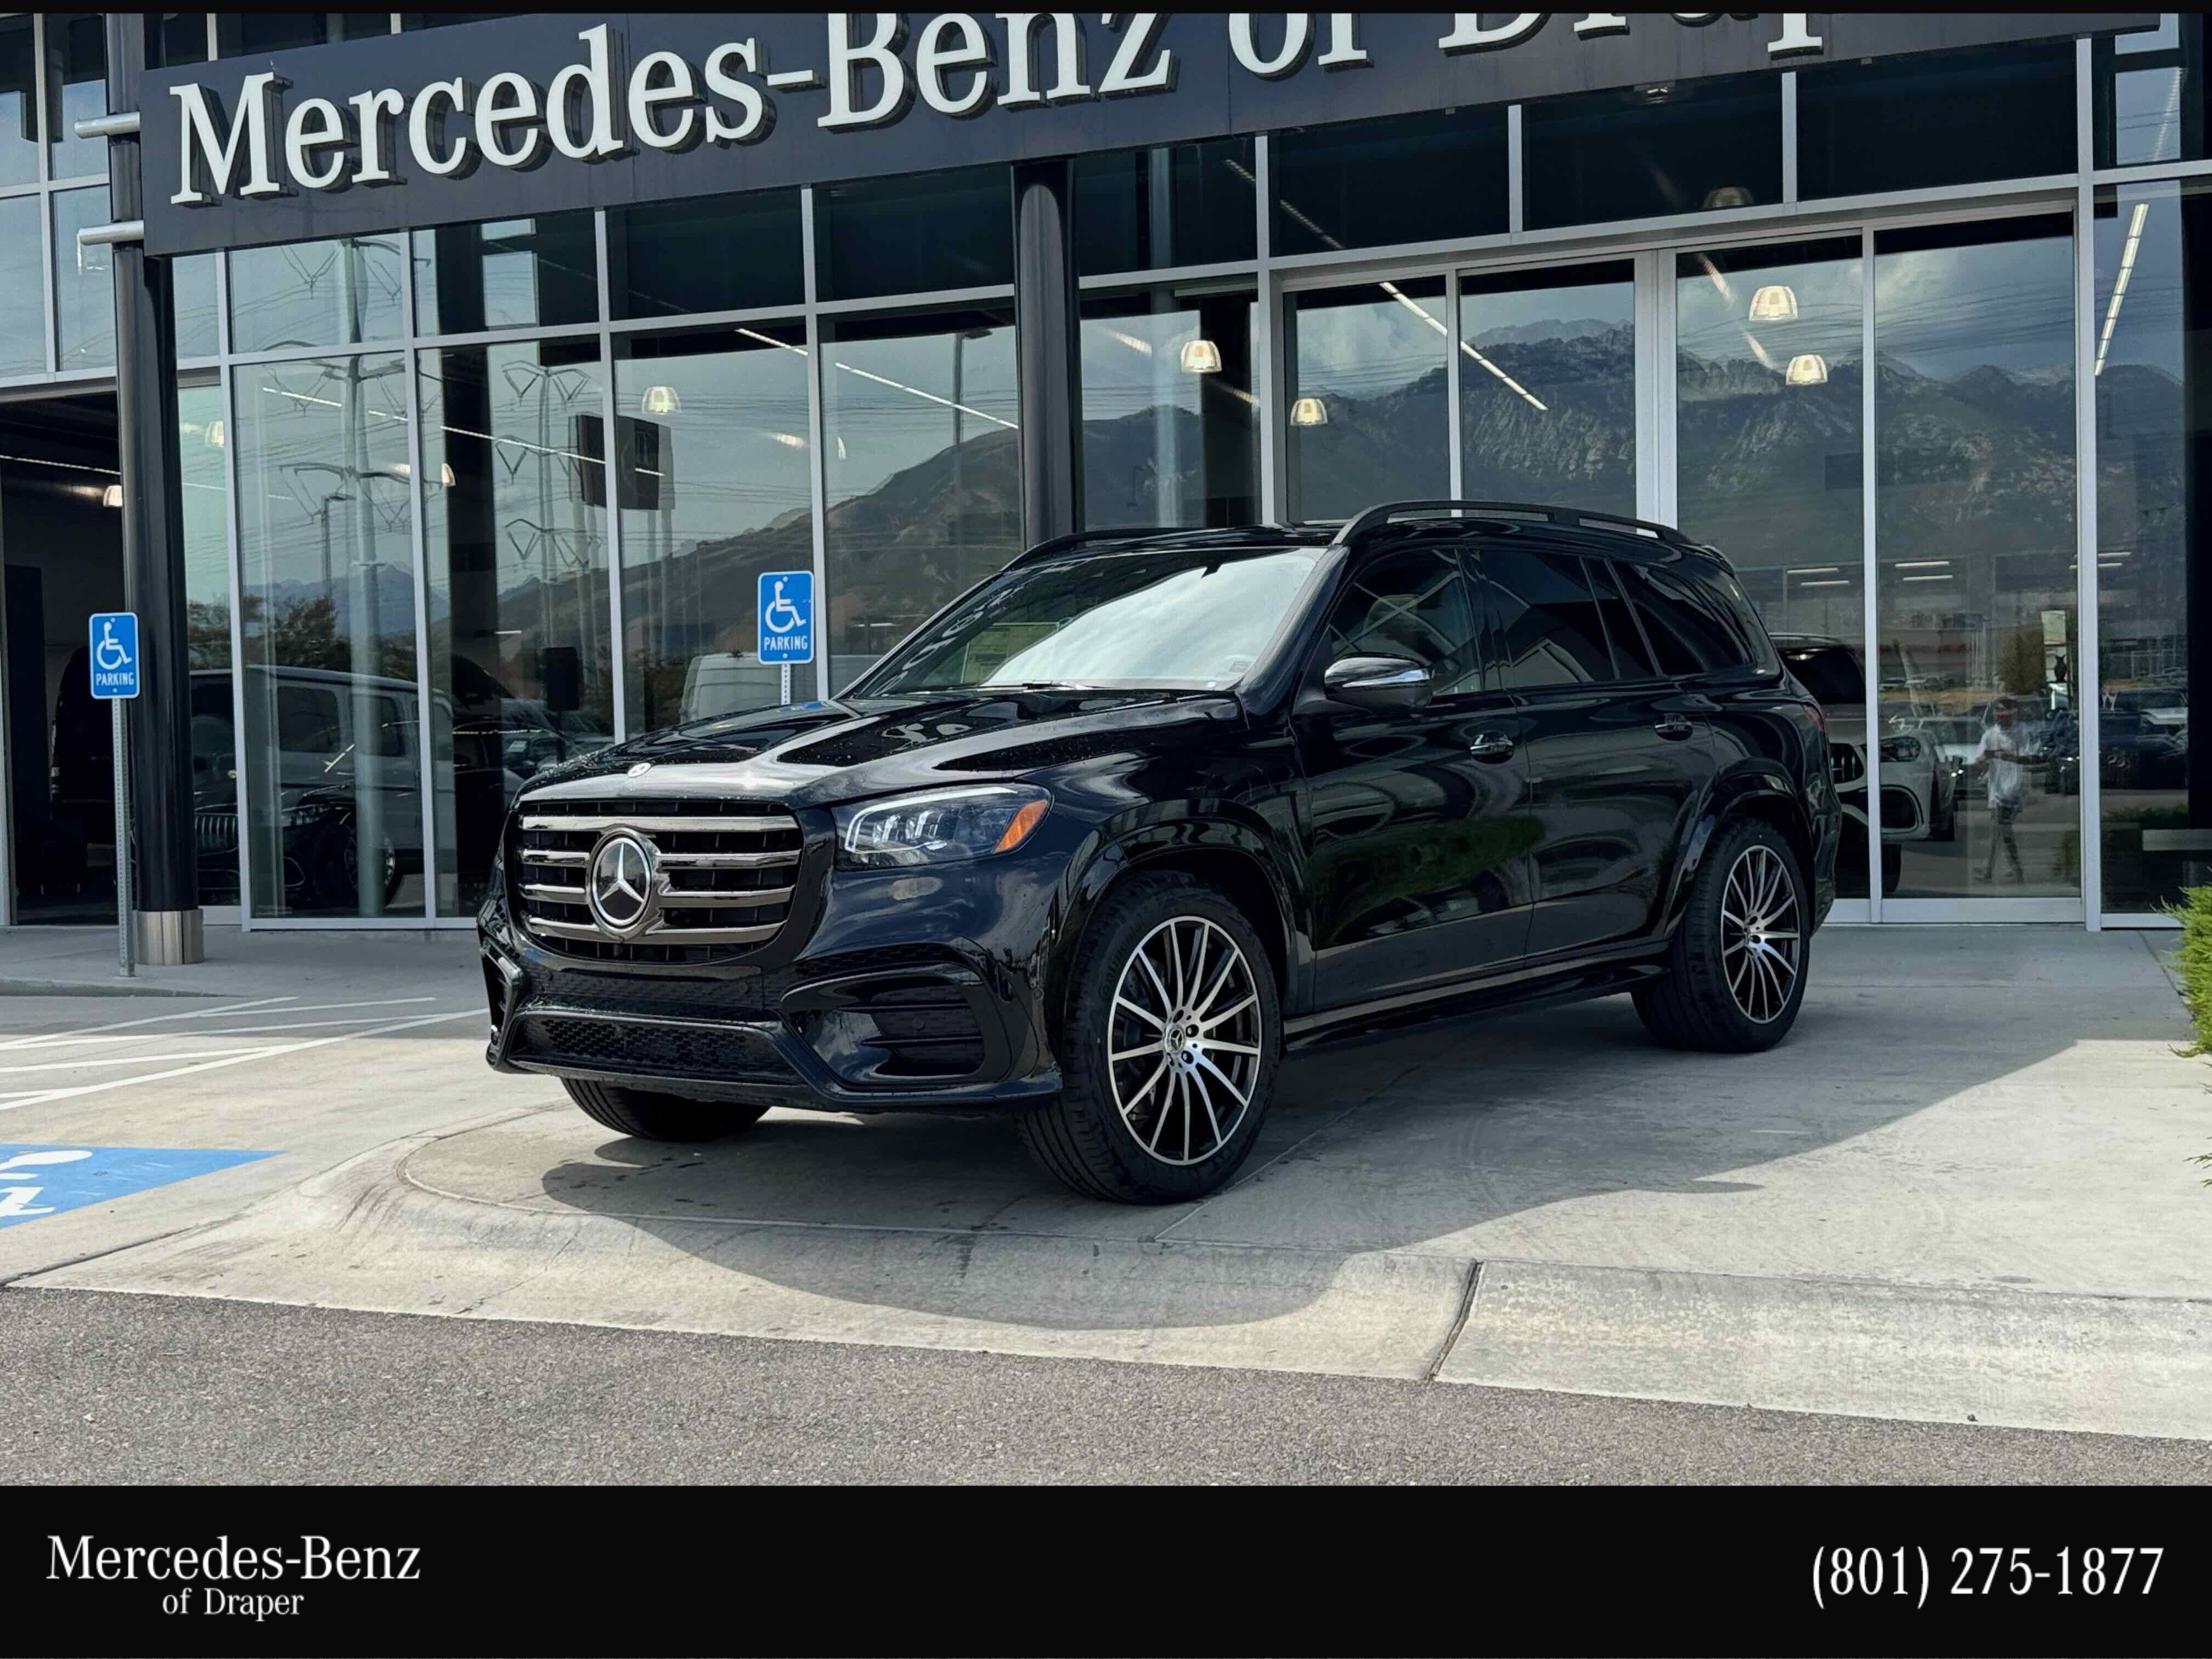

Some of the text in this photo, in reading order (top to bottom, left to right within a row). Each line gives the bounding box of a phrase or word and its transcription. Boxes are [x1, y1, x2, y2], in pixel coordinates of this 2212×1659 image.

[169, 13, 1171, 205] Mercedes-Benz
[763, 635, 808, 651] PARKING
[96, 672, 134, 686] PARKING
